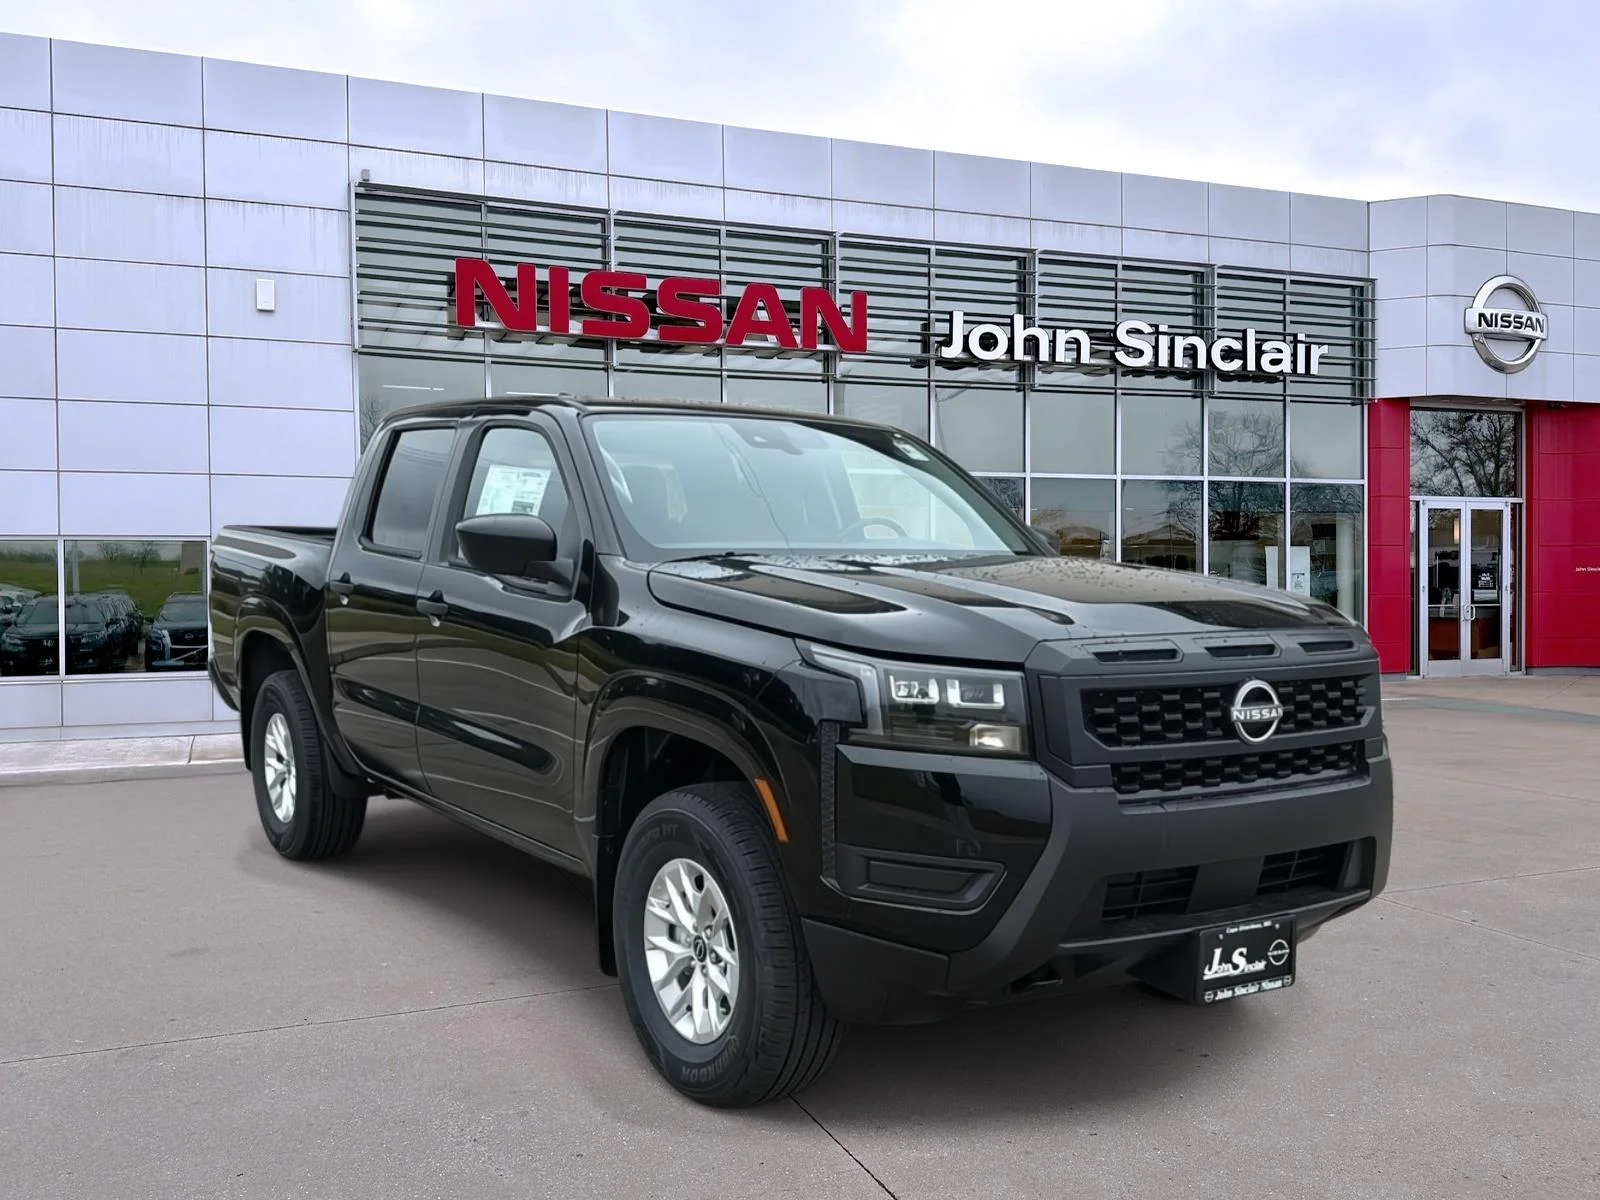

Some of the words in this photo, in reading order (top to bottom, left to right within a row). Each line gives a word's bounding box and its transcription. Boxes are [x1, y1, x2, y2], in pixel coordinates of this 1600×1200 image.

[455, 257, 868, 353] NISSAN
[1477, 312, 1545, 334] NISSAN
[940, 310, 1090, 364] John
[1114, 319, 1329, 375] Sinclair
[1233, 707, 1283, 720] NISSAN
